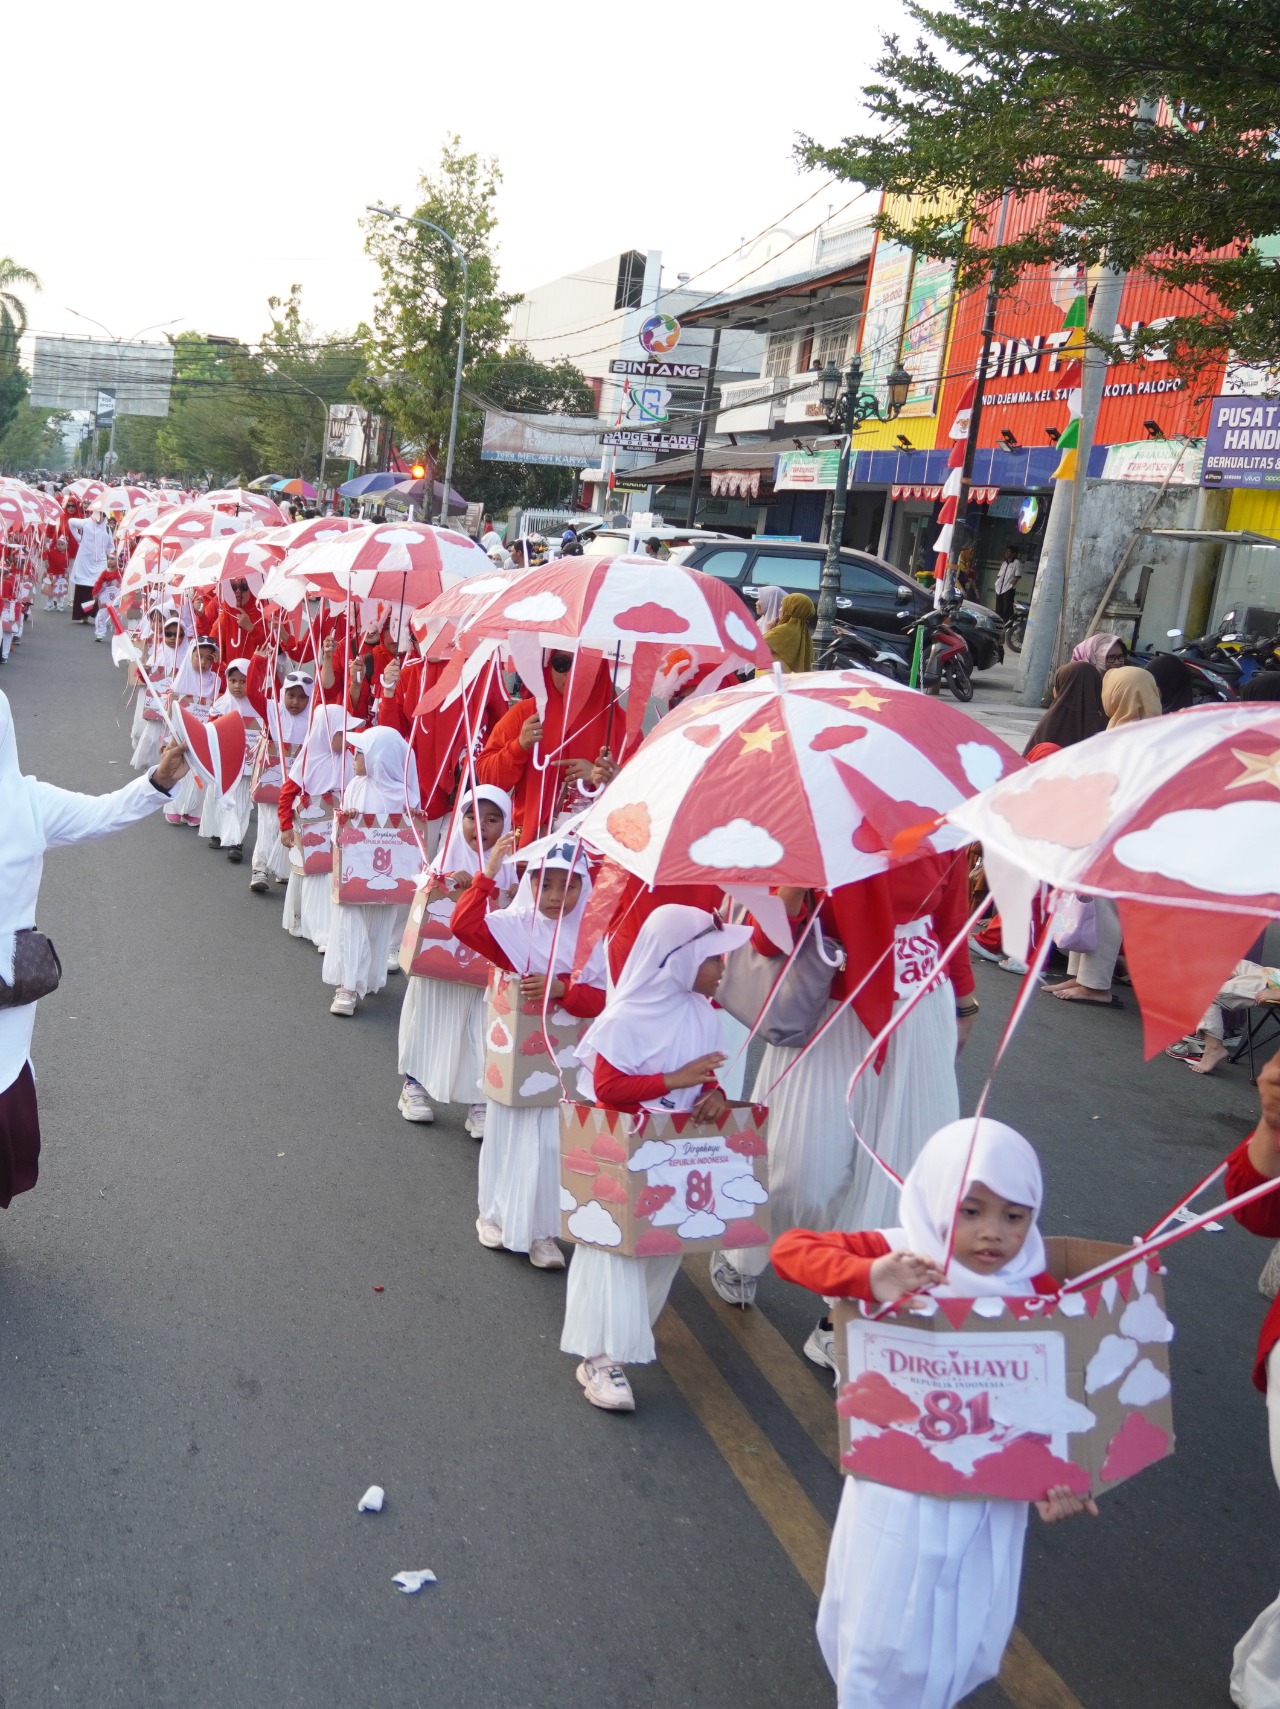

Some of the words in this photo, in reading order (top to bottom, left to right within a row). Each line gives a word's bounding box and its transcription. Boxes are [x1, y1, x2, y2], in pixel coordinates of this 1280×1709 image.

[976, 316, 1178, 379] BINTNG
[612, 361, 700, 378] BINTANG
[1034, 389, 1051, 401] KEL
[1104, 383, 1133, 398] KOTA
[1136, 377, 1181, 394] PALOPO
[1217, 406, 1275, 428] PUSAT
[604, 431, 658, 442] GADGET
[660, 434, 697, 446] CARE
[1207, 456, 1274, 470] BERKUALITAS
[1244, 474, 1261, 482] vivo
[683, 1141, 721, 1158] Dirgahayu
[668, 1158, 696, 1167] REPUBLIK
[697, 1156, 730, 1165] INDONESIA
[685, 1169, 714, 1211] 81
[880, 1348, 1029, 1381] DIRGAHAYU
[910, 1376, 953, 1389] REPUBLIK
[955, 1380, 1005, 1389] INDONESIA
[917, 1390, 995, 1442] 81
